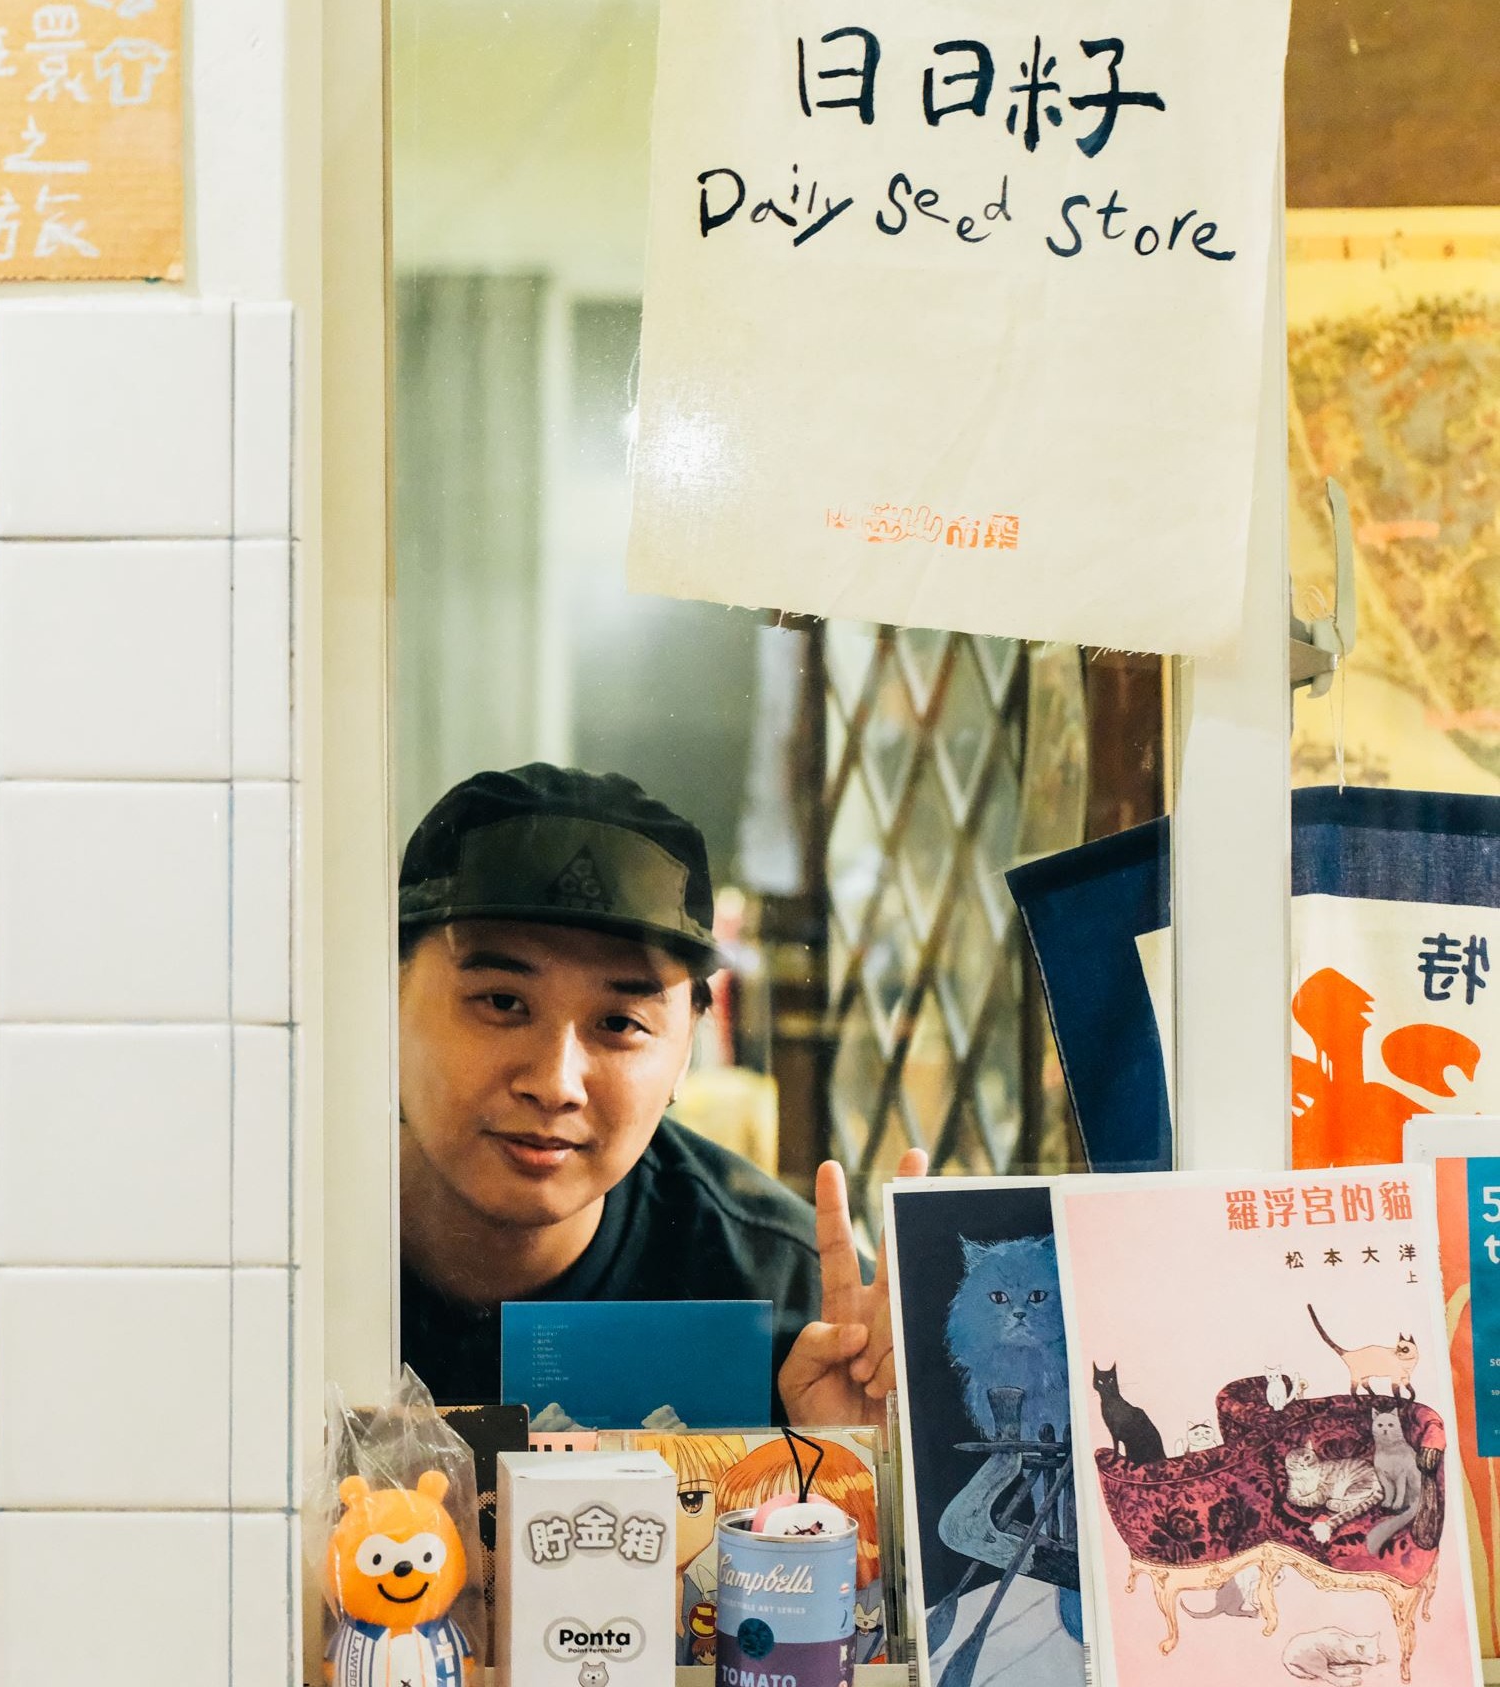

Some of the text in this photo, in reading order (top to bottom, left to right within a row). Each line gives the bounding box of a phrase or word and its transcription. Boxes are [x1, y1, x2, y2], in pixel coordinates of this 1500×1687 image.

[698, 164, 1237, 260] Daily Seed Store
[1225, 1181, 1413, 1231] 羅浮宮的貓
[1406, 1271, 1418, 1284] 上
[528, 1505, 666, 1563] 貯金箱
[559, 1629, 631, 1646] Ponta
[722, 1664, 797, 1687] TOMATO
